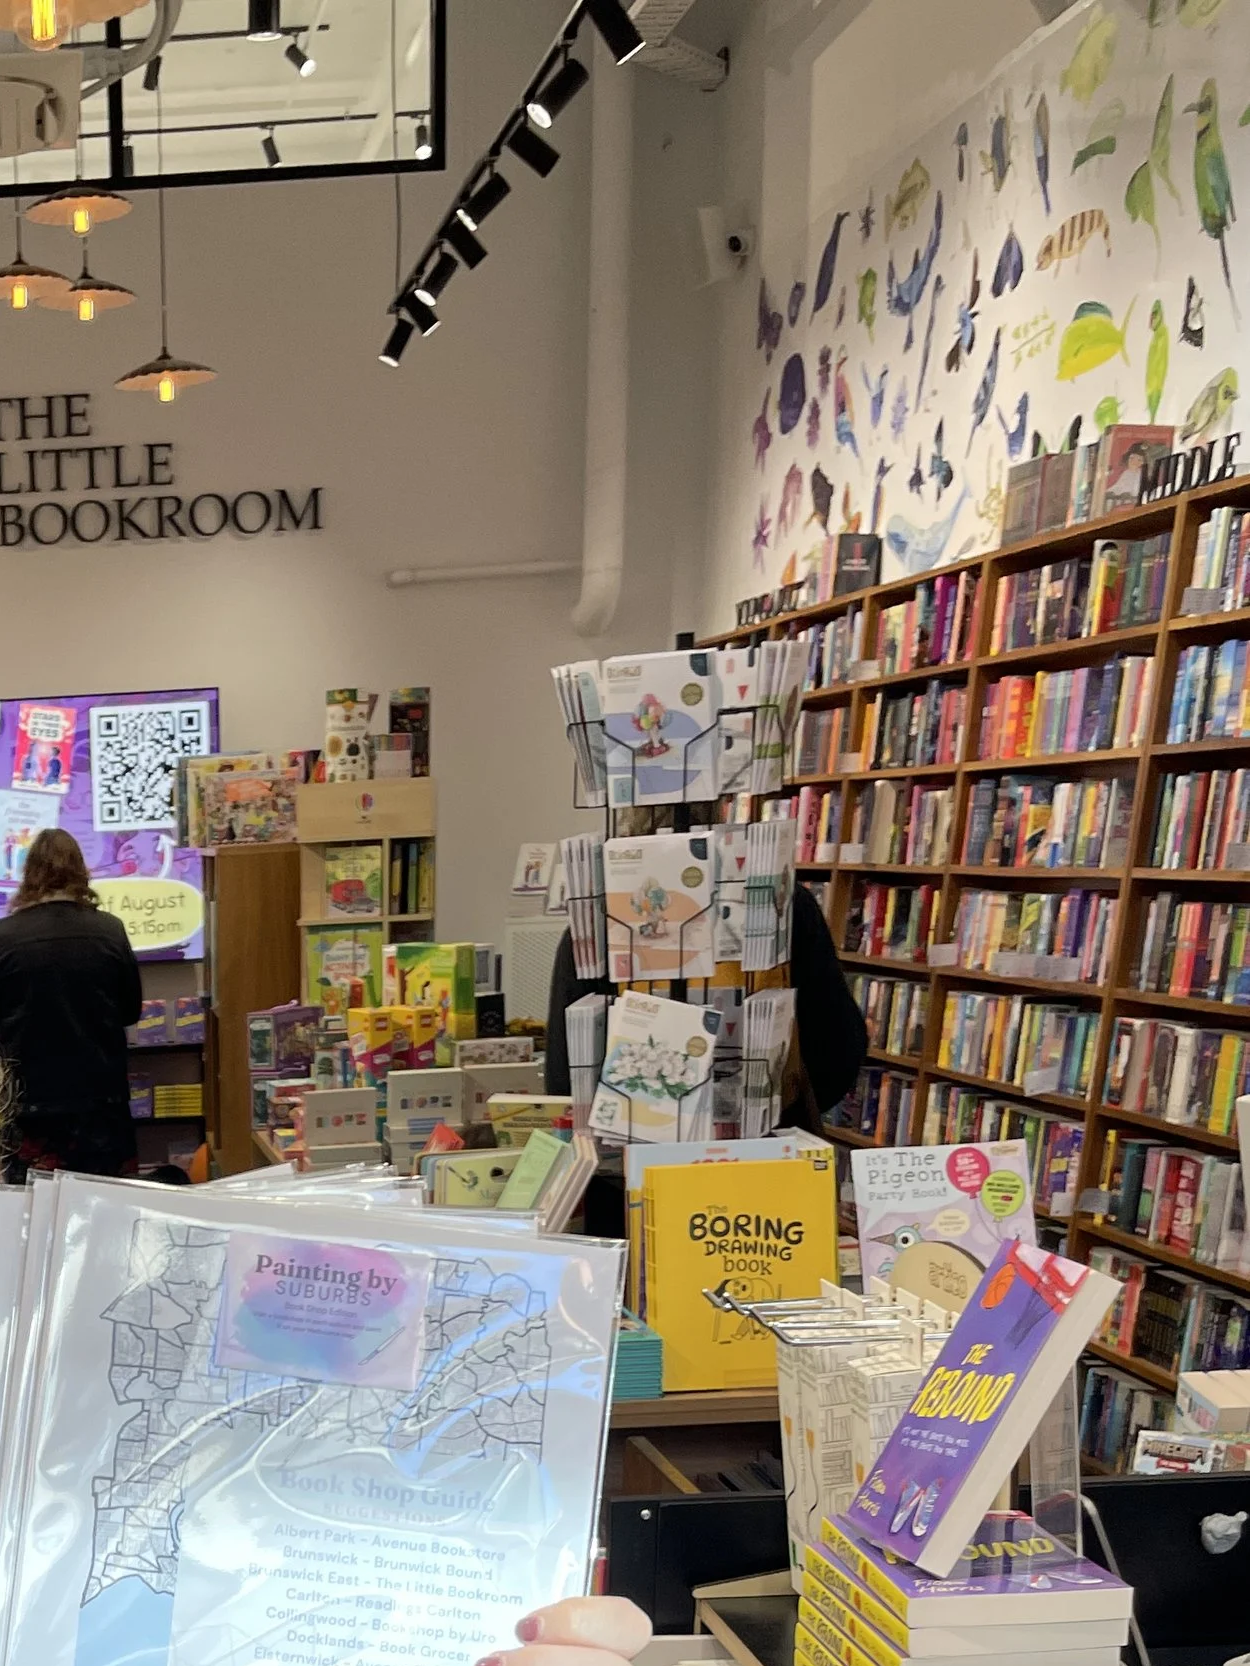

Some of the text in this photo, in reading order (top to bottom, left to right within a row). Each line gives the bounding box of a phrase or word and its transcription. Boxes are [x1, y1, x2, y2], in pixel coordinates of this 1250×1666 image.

[30, 728, 59, 739] EYES
[121, 893, 185, 916] August
[128, 919, 182, 938] 5:15pm
[894, 1152, 935, 1167] The
[868, 1168, 945, 1189] Pigeon
[706, 1205, 728, 1215] The
[689, 1213, 804, 1245] BORING
[704, 1239, 792, 1261] DRAWING
[253, 1253, 398, 1297] Painting by
[723, 1256, 772, 1276] book
[274, 1279, 371, 1306] SUBURBS
[961, 1343, 994, 1366] THE
[909, 1366, 1016, 1425] REBOUND
[280, 1469, 495, 1512] Book Shop Guide
[273, 1524, 505, 1562] Albert Park Avenue Booktore
[283, 1545, 358, 1566] Brunswick
[374, 1555, 441, 1576] Brunwick
[248, 1562, 323, 1583] Brunswick
[328, 1571, 359, 1587] East
[375, 1577, 402, 1592] The
[447, 1586, 523, 1606] Bookroom
[266, 1605, 496, 1645] Collingwood by Uro
[426, 1604, 481, 1622] Carlton
[286, 1629, 470, 1663] Docklands Book Grocer
